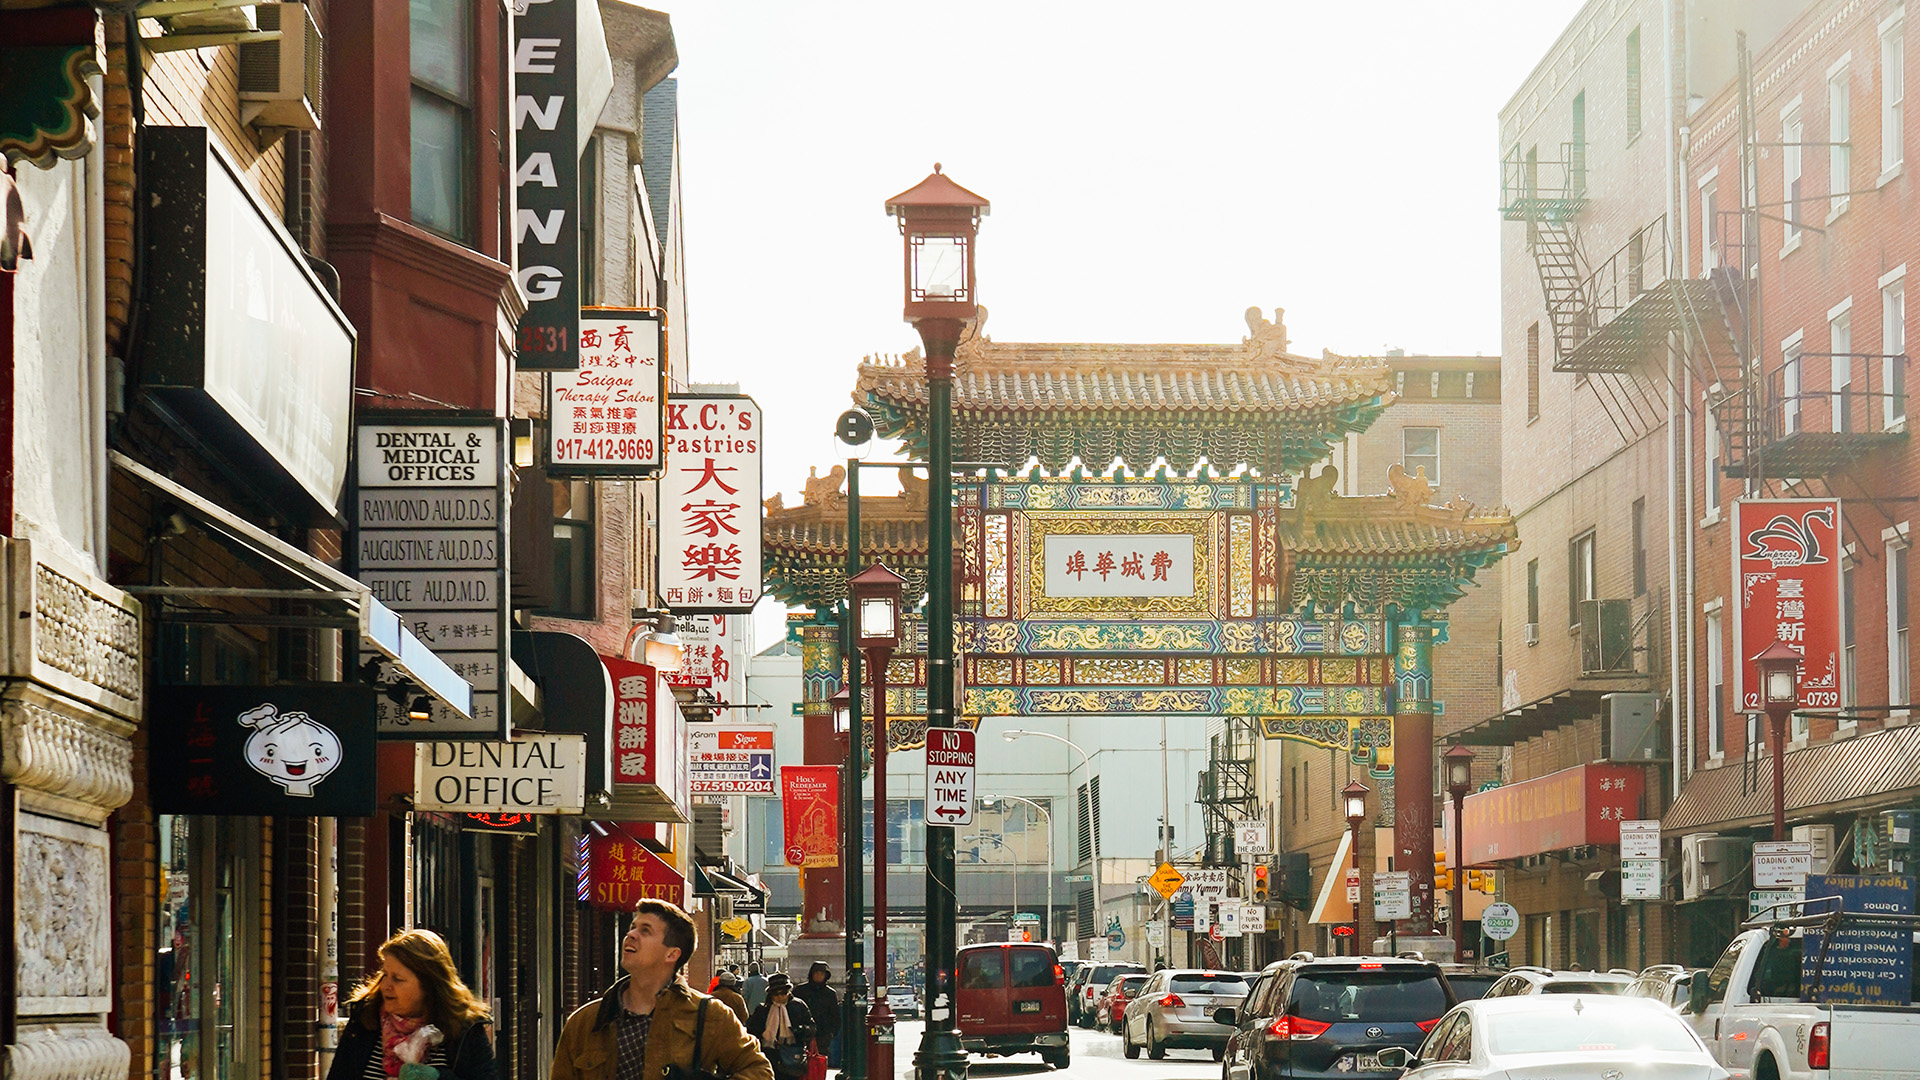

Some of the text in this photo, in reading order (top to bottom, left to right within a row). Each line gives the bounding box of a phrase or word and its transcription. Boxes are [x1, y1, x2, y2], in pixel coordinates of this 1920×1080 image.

[581, 354, 656, 368] 理容中心
[576, 371, 634, 391] Saigon
[555, 388, 656, 405] Therapy Salon
[669, 404, 752, 431] K.C.'s
[376, 433, 482, 447] DENTAL &
[663, 434, 757, 453] Pastries
[556, 438, 653, 460] 917-412-9669
[383, 450, 480, 464] MEDICAL
[388, 466, 476, 481] OFFICES
[364, 500, 429, 521] RAYMOND
[680, 457, 742, 582] 大家樂
[361, 540, 433, 561] AUGUSTINE
[371, 580, 412, 602] FELICE
[691, 677, 708, 685] Floor
[942, 731, 961, 750] NO
[431, 742, 565, 769] DENTAL
[929, 750, 974, 764] STOPPING
[935, 770, 967, 784] ANY
[435, 775, 554, 806] OFFICE
[1600, 777, 1626, 792] 海鮮
[934, 788, 967, 802] TIME
[1600, 807, 1625, 821] 蔬菜
[790, 849, 802, 860] 75
[1196, 883, 1224, 895] Yummy
[1824, 877, 1908, 890] Types of Bikes
[598, 882, 681, 905] SIU KEE
[1863, 903, 1899, 912] Demos
[1332, 926, 1354, 936] OPEN
[1836, 930, 1898, 939] Professional
[1864, 943, 1897, 952] Wheel
[1838, 956, 1897, 967] Accessories
[1850, 970, 1875, 980] Rack
[1878, 970, 1896, 979] Car
[1829, 983, 1862, 996] Types
[1866, 985, 1881, 995] All
